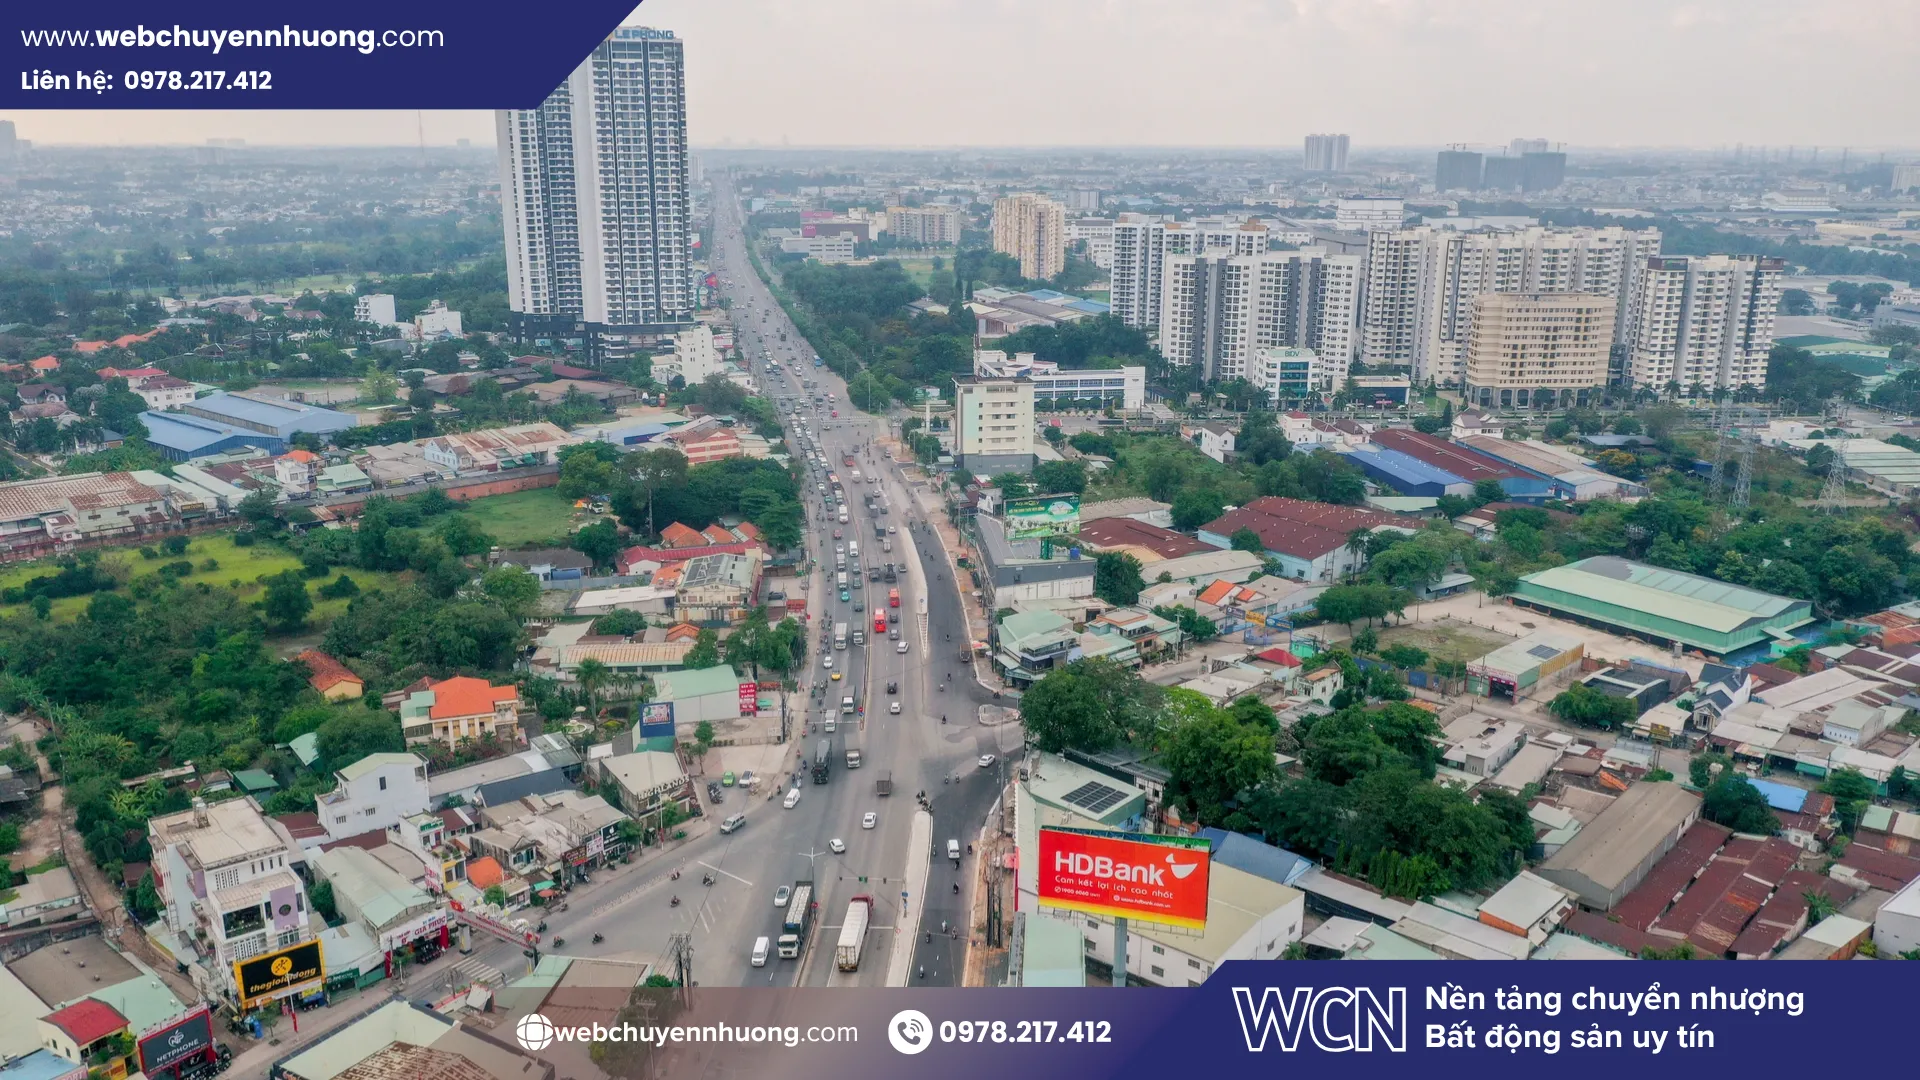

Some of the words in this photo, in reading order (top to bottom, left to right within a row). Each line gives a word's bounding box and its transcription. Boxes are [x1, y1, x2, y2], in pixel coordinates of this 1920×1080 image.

[1055, 850, 1165, 887] HDBank
[1055, 875, 1074, 884] Cam
[156, 1038, 199, 1063] NETPHONE
